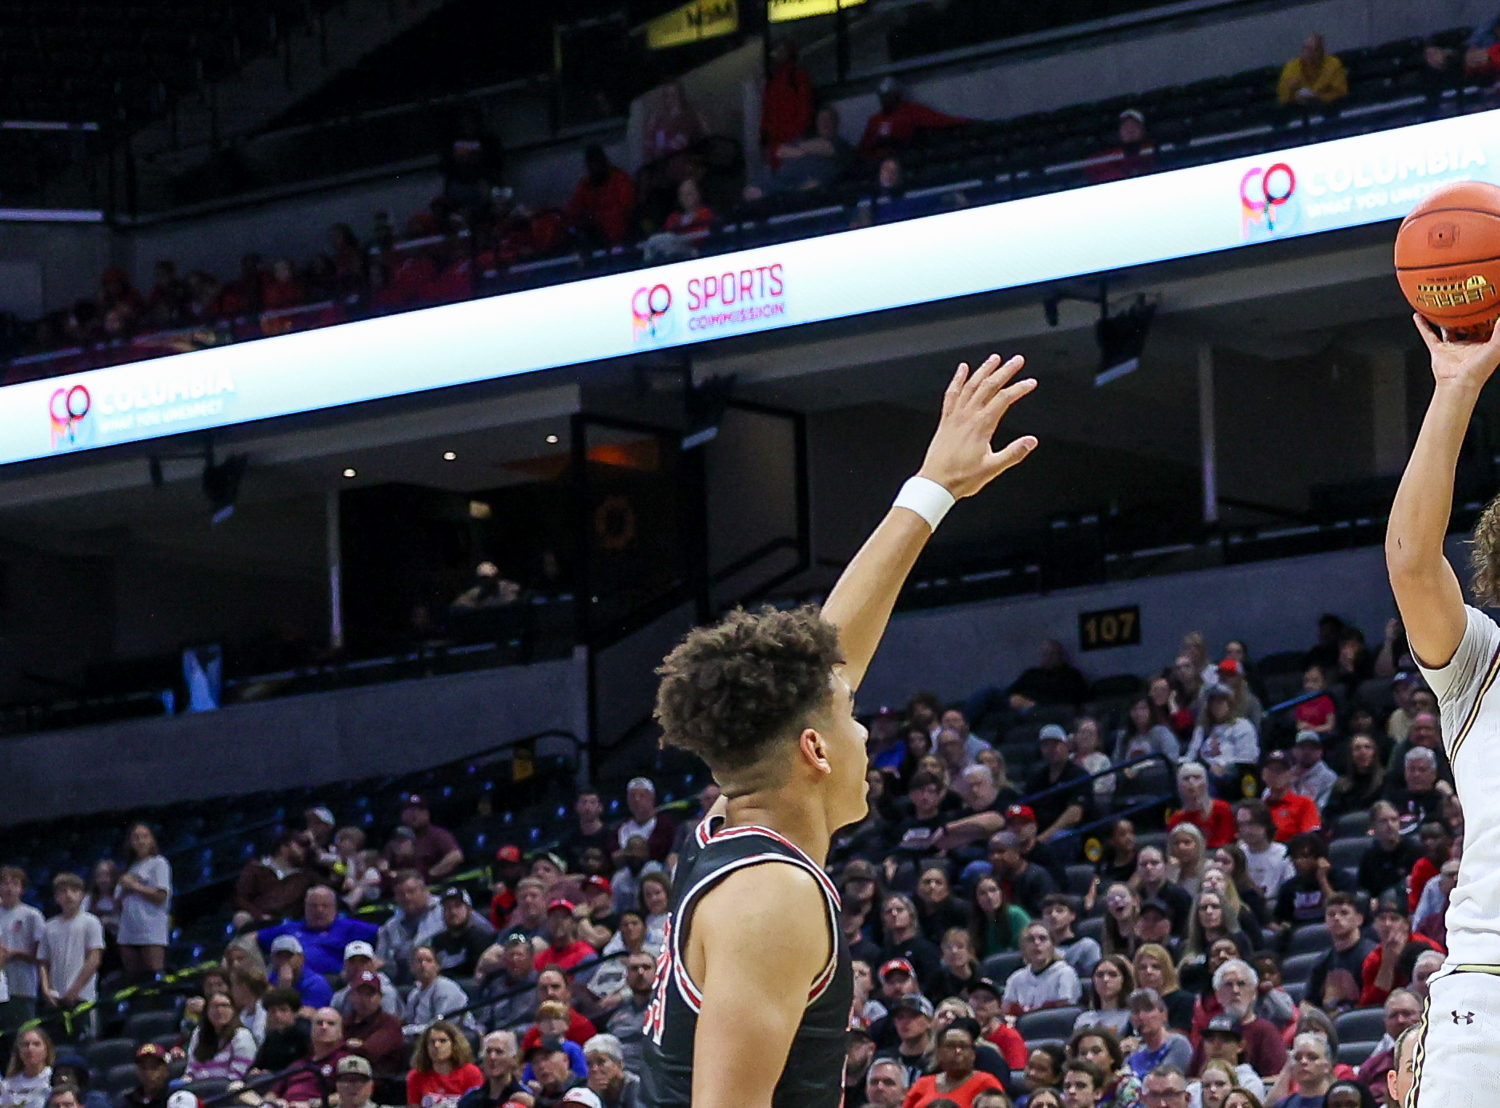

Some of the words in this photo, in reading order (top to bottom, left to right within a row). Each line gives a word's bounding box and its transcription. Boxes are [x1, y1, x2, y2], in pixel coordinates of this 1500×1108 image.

[1304, 139, 1487, 197] COLUMBIA
[688, 263, 783, 311] SPORTS
[688, 302, 784, 331] COMMISSION
[97, 365, 236, 414] COLUMBIA
[1085, 612, 1135, 643] 107
